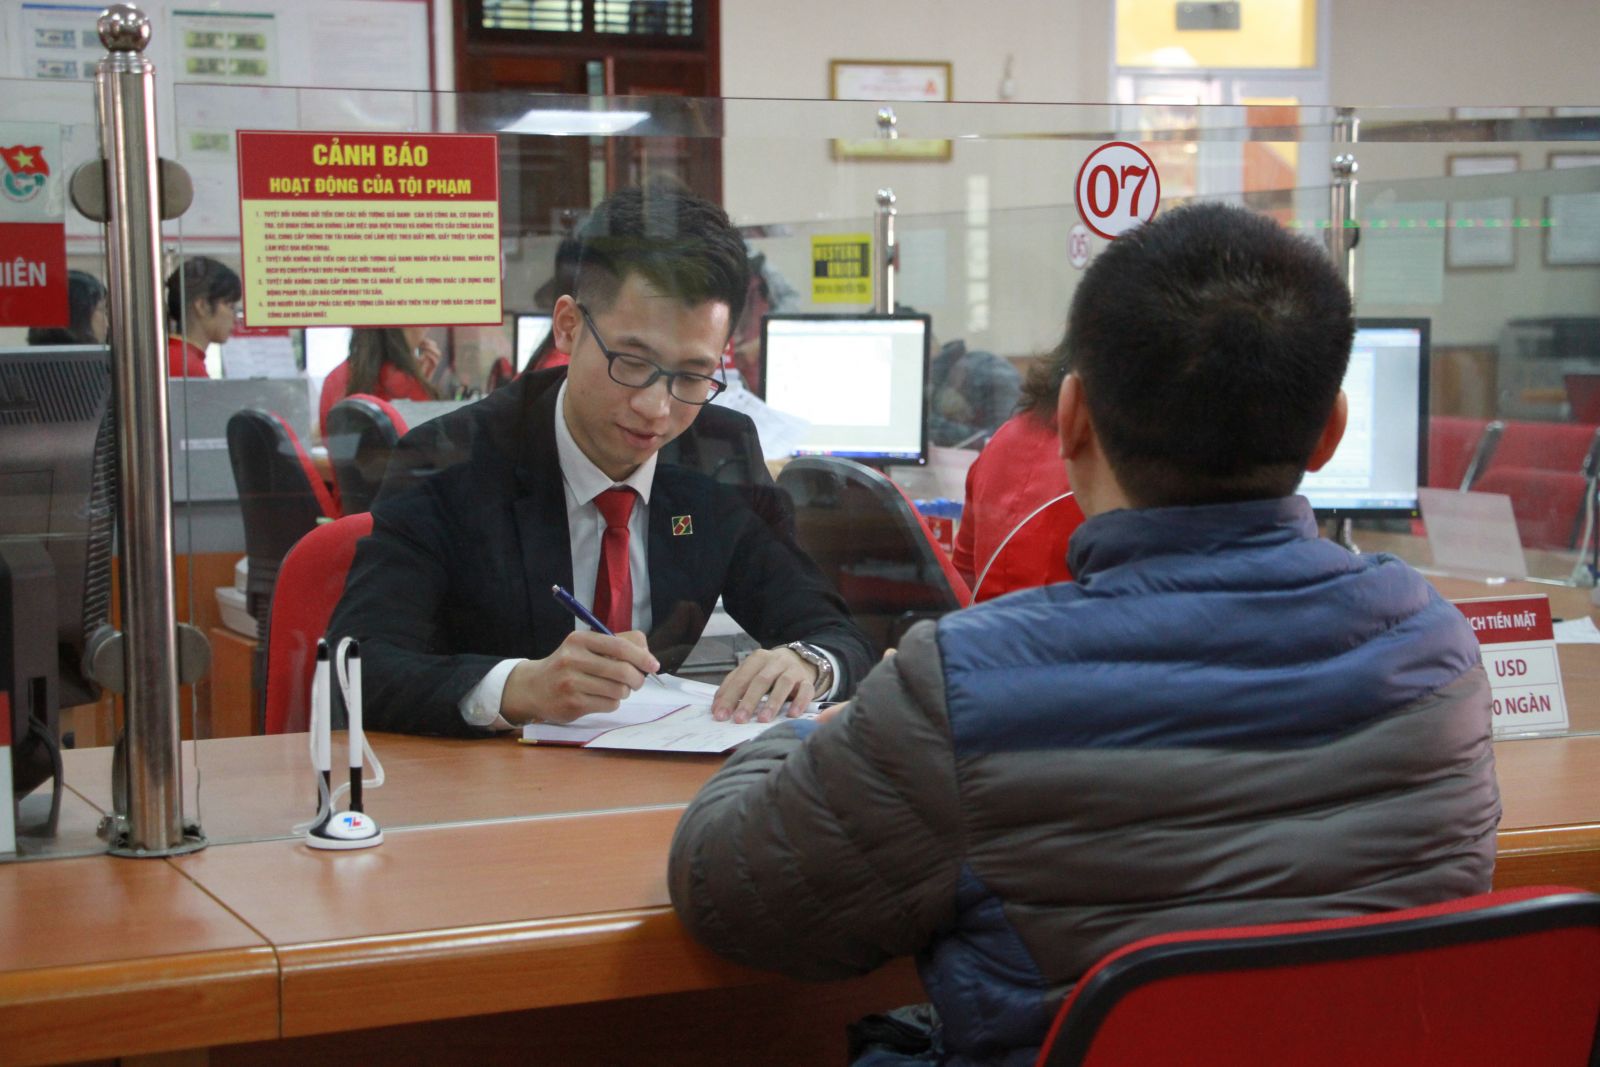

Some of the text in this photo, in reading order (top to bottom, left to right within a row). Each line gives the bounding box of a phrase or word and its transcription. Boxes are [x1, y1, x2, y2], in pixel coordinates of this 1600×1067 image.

[312, 138, 428, 166] CẢNH BÁO
[270, 174, 471, 197] HOẠT ĐỘNG CỦA TỘI PHẠM
[1087, 164, 1150, 218] 07
[1513, 610, 1536, 631] MẶT
[1495, 659, 1527, 677] USD
[1505, 692, 1551, 714] NGÀN
